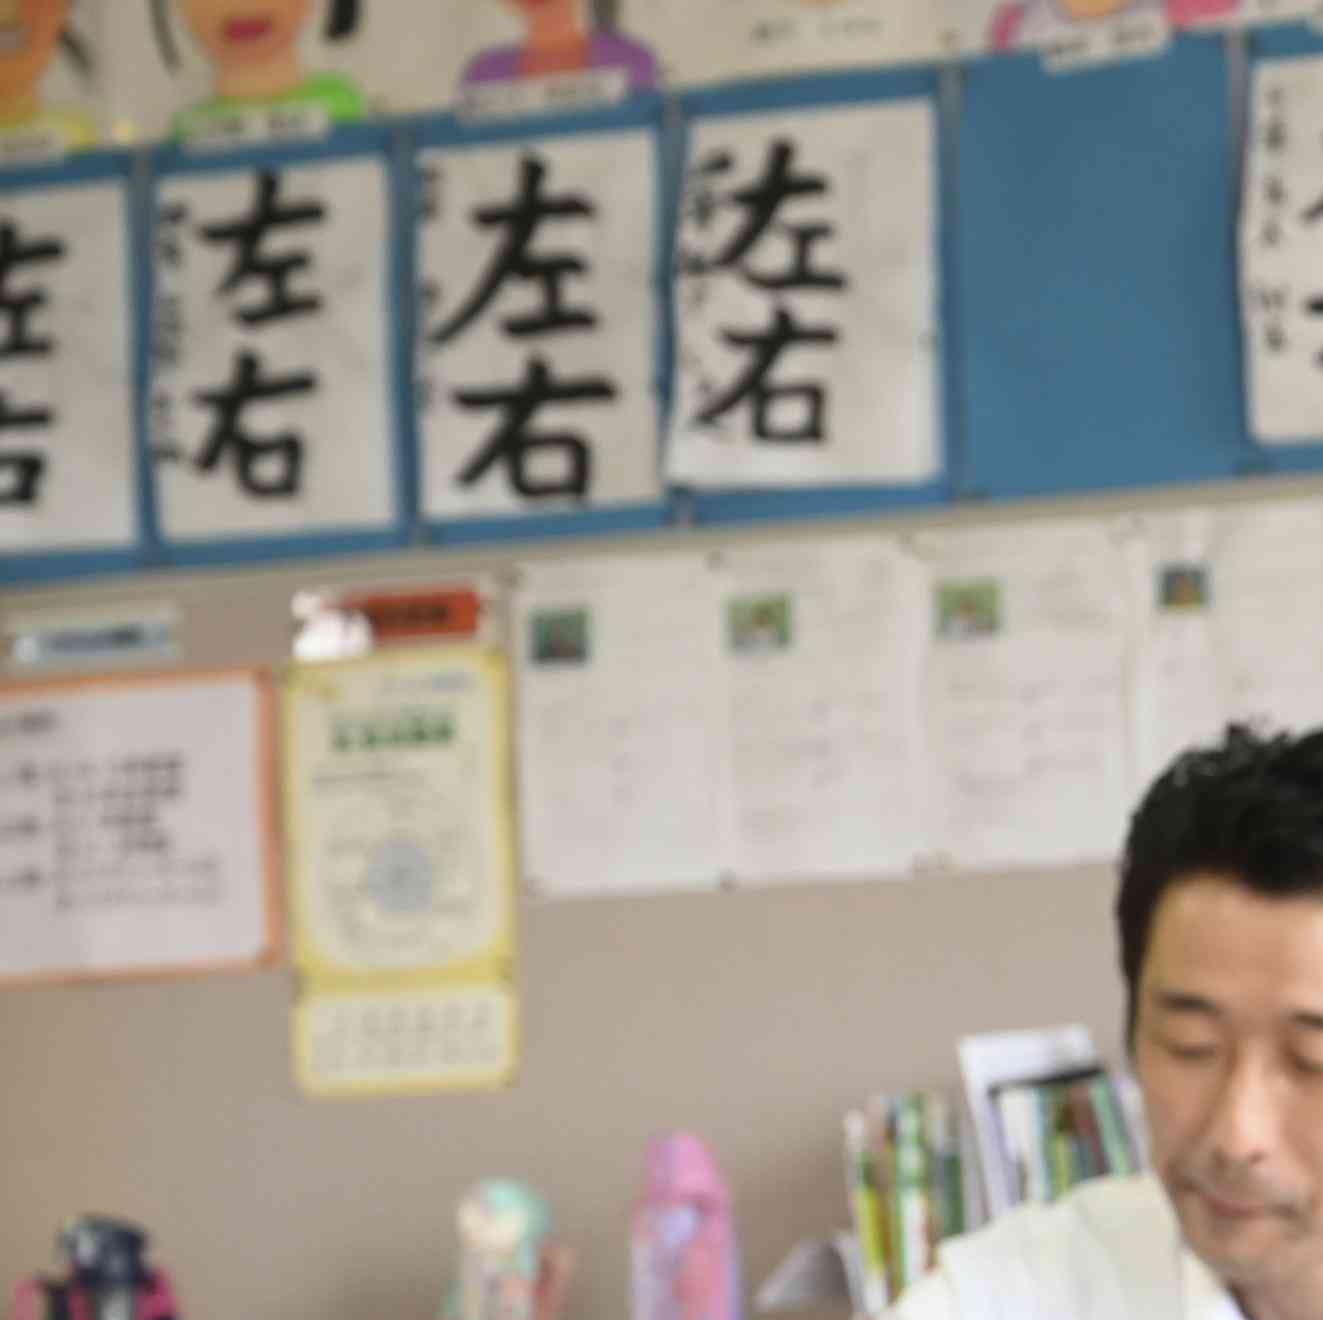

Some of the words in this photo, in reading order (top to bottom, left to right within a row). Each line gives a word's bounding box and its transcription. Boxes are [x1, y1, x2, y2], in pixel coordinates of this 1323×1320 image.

[193, 166, 325, 502] 左右
[427, 148, 618, 499] 左右
[692, 136, 848, 445] 左右
